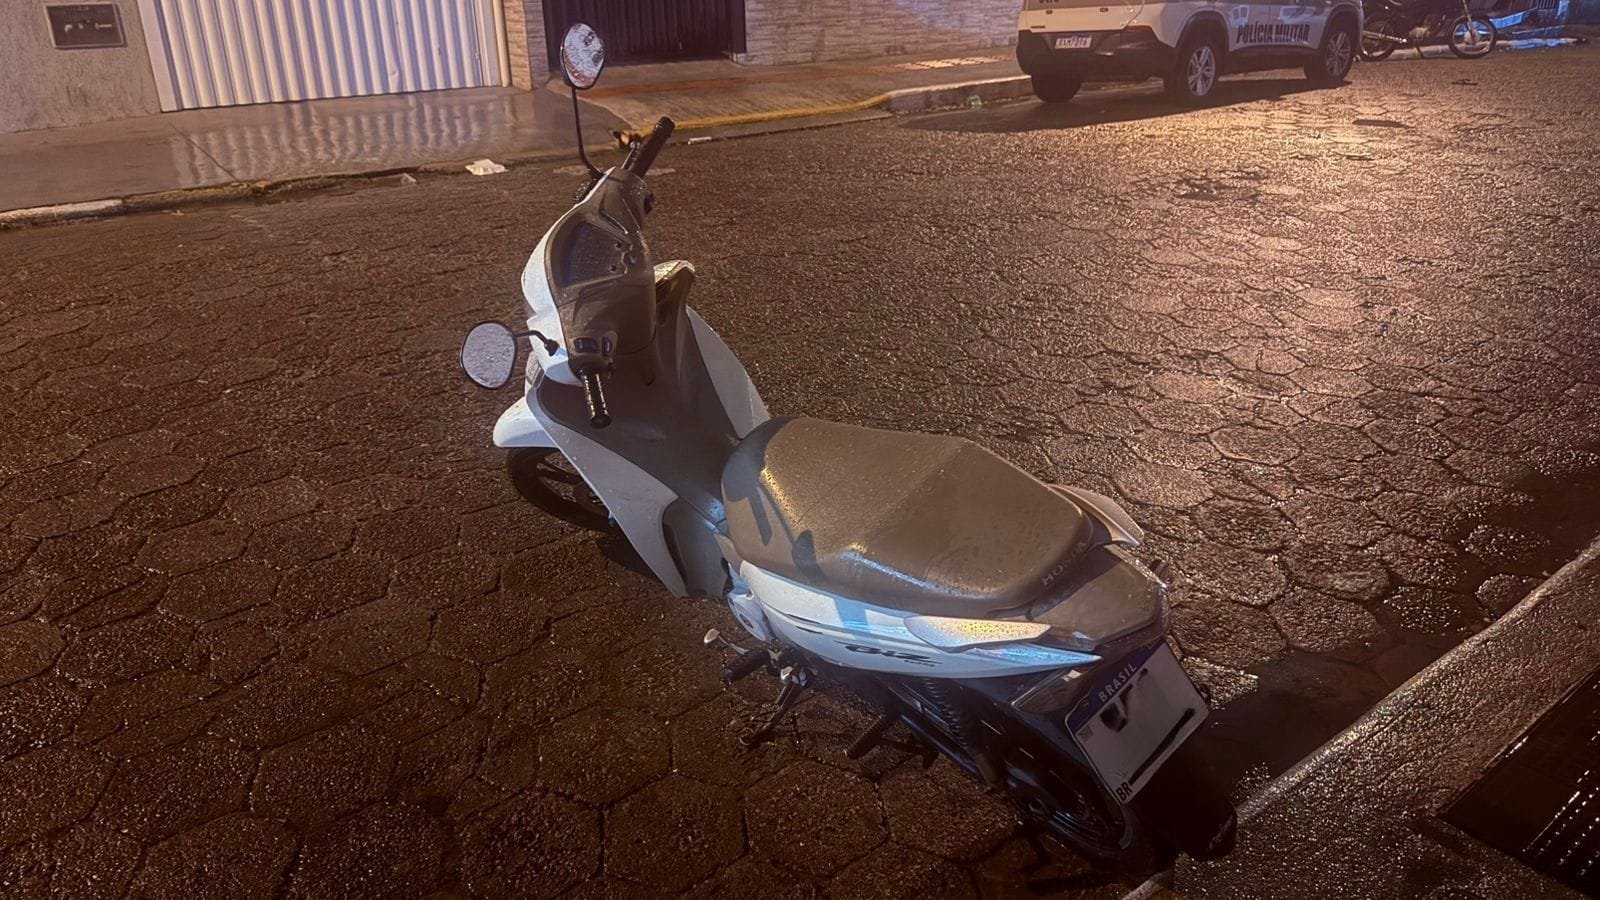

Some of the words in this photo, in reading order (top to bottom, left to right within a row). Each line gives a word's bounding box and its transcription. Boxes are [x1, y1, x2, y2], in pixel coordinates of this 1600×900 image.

[1236, 21, 1273, 43] POLÍCIA
[1275, 24, 1310, 42] MILITAR
[1098, 663, 1138, 703] BRASIL
[1115, 781, 1133, 801] BR
